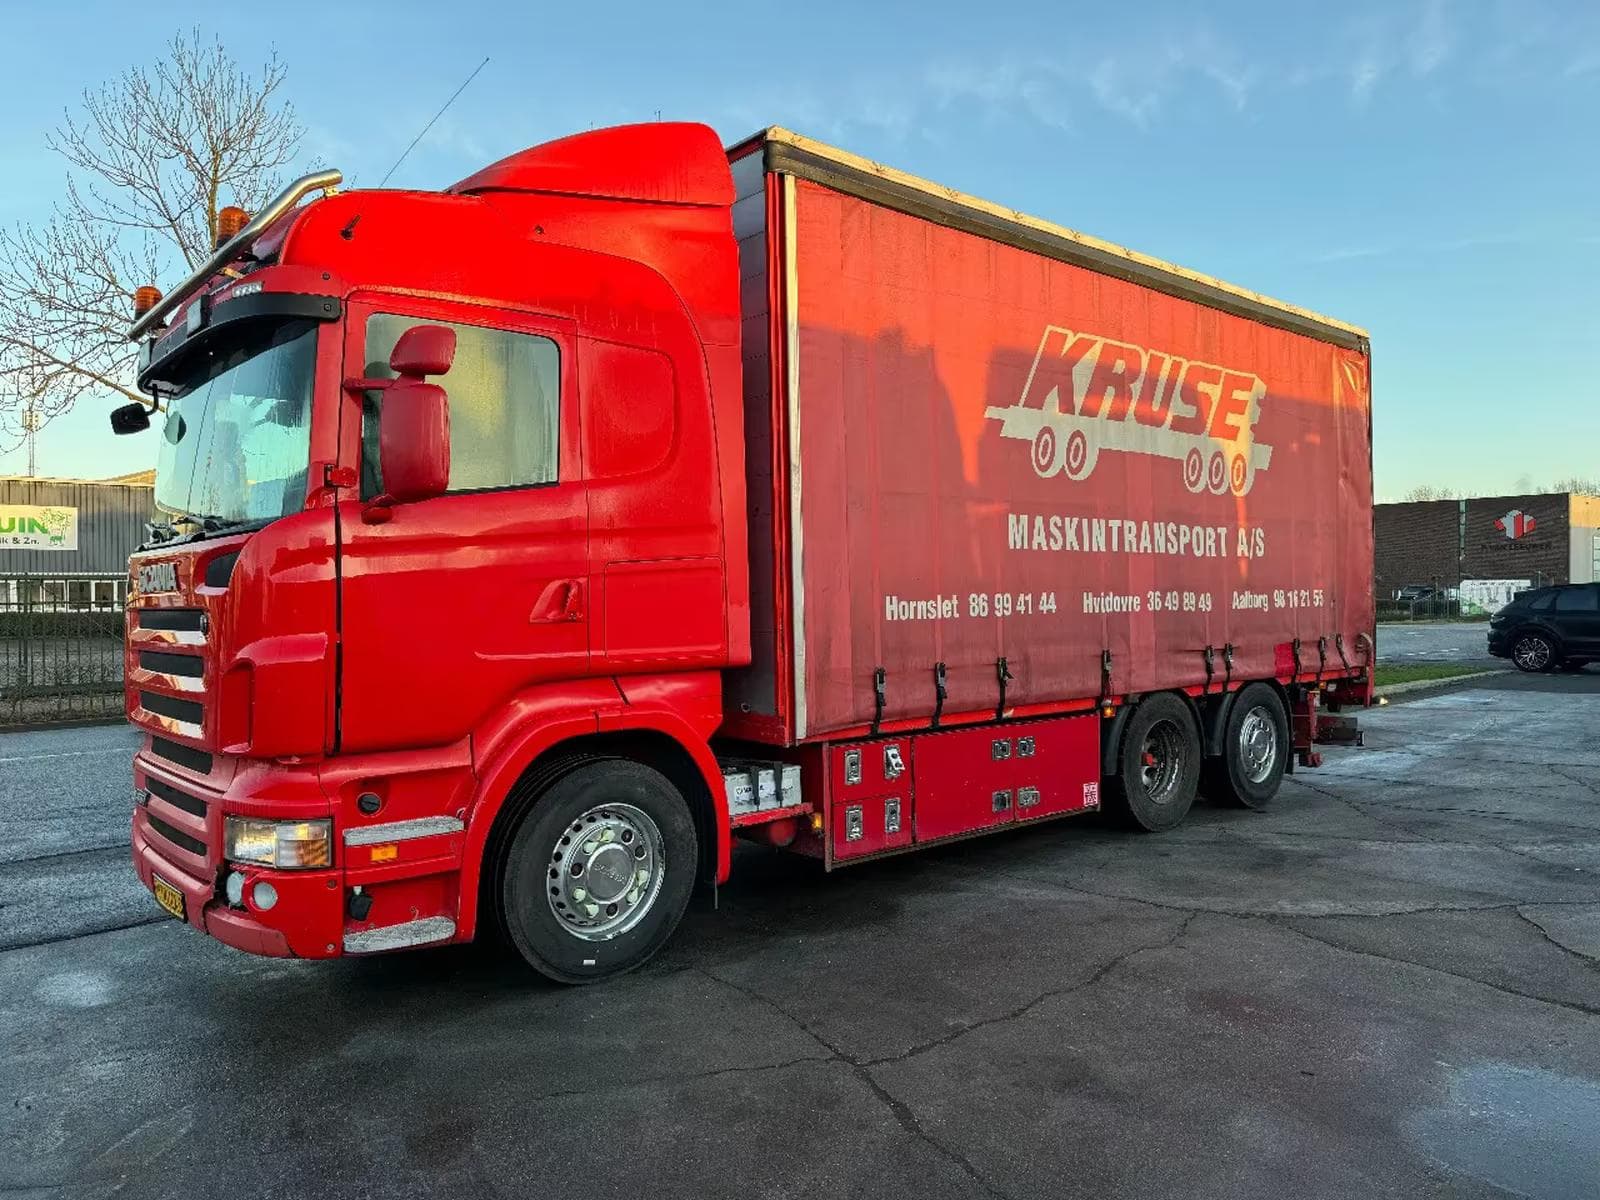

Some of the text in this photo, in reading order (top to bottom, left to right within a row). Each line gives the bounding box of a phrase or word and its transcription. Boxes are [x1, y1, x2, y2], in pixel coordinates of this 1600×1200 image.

[1019, 325, 1266, 442] KRUSE
[1008, 513, 1265, 559] MASKINTRANSPORT A/S
[885, 592, 1057, 621] Hornslet 86 99 41 44
[1083, 591, 1212, 613] Hvidovre 36 49 89 49
[1232, 590, 1268, 612] Aalborg
[1273, 589, 1285, 608] 98
[1300, 590, 1310, 607] 21
